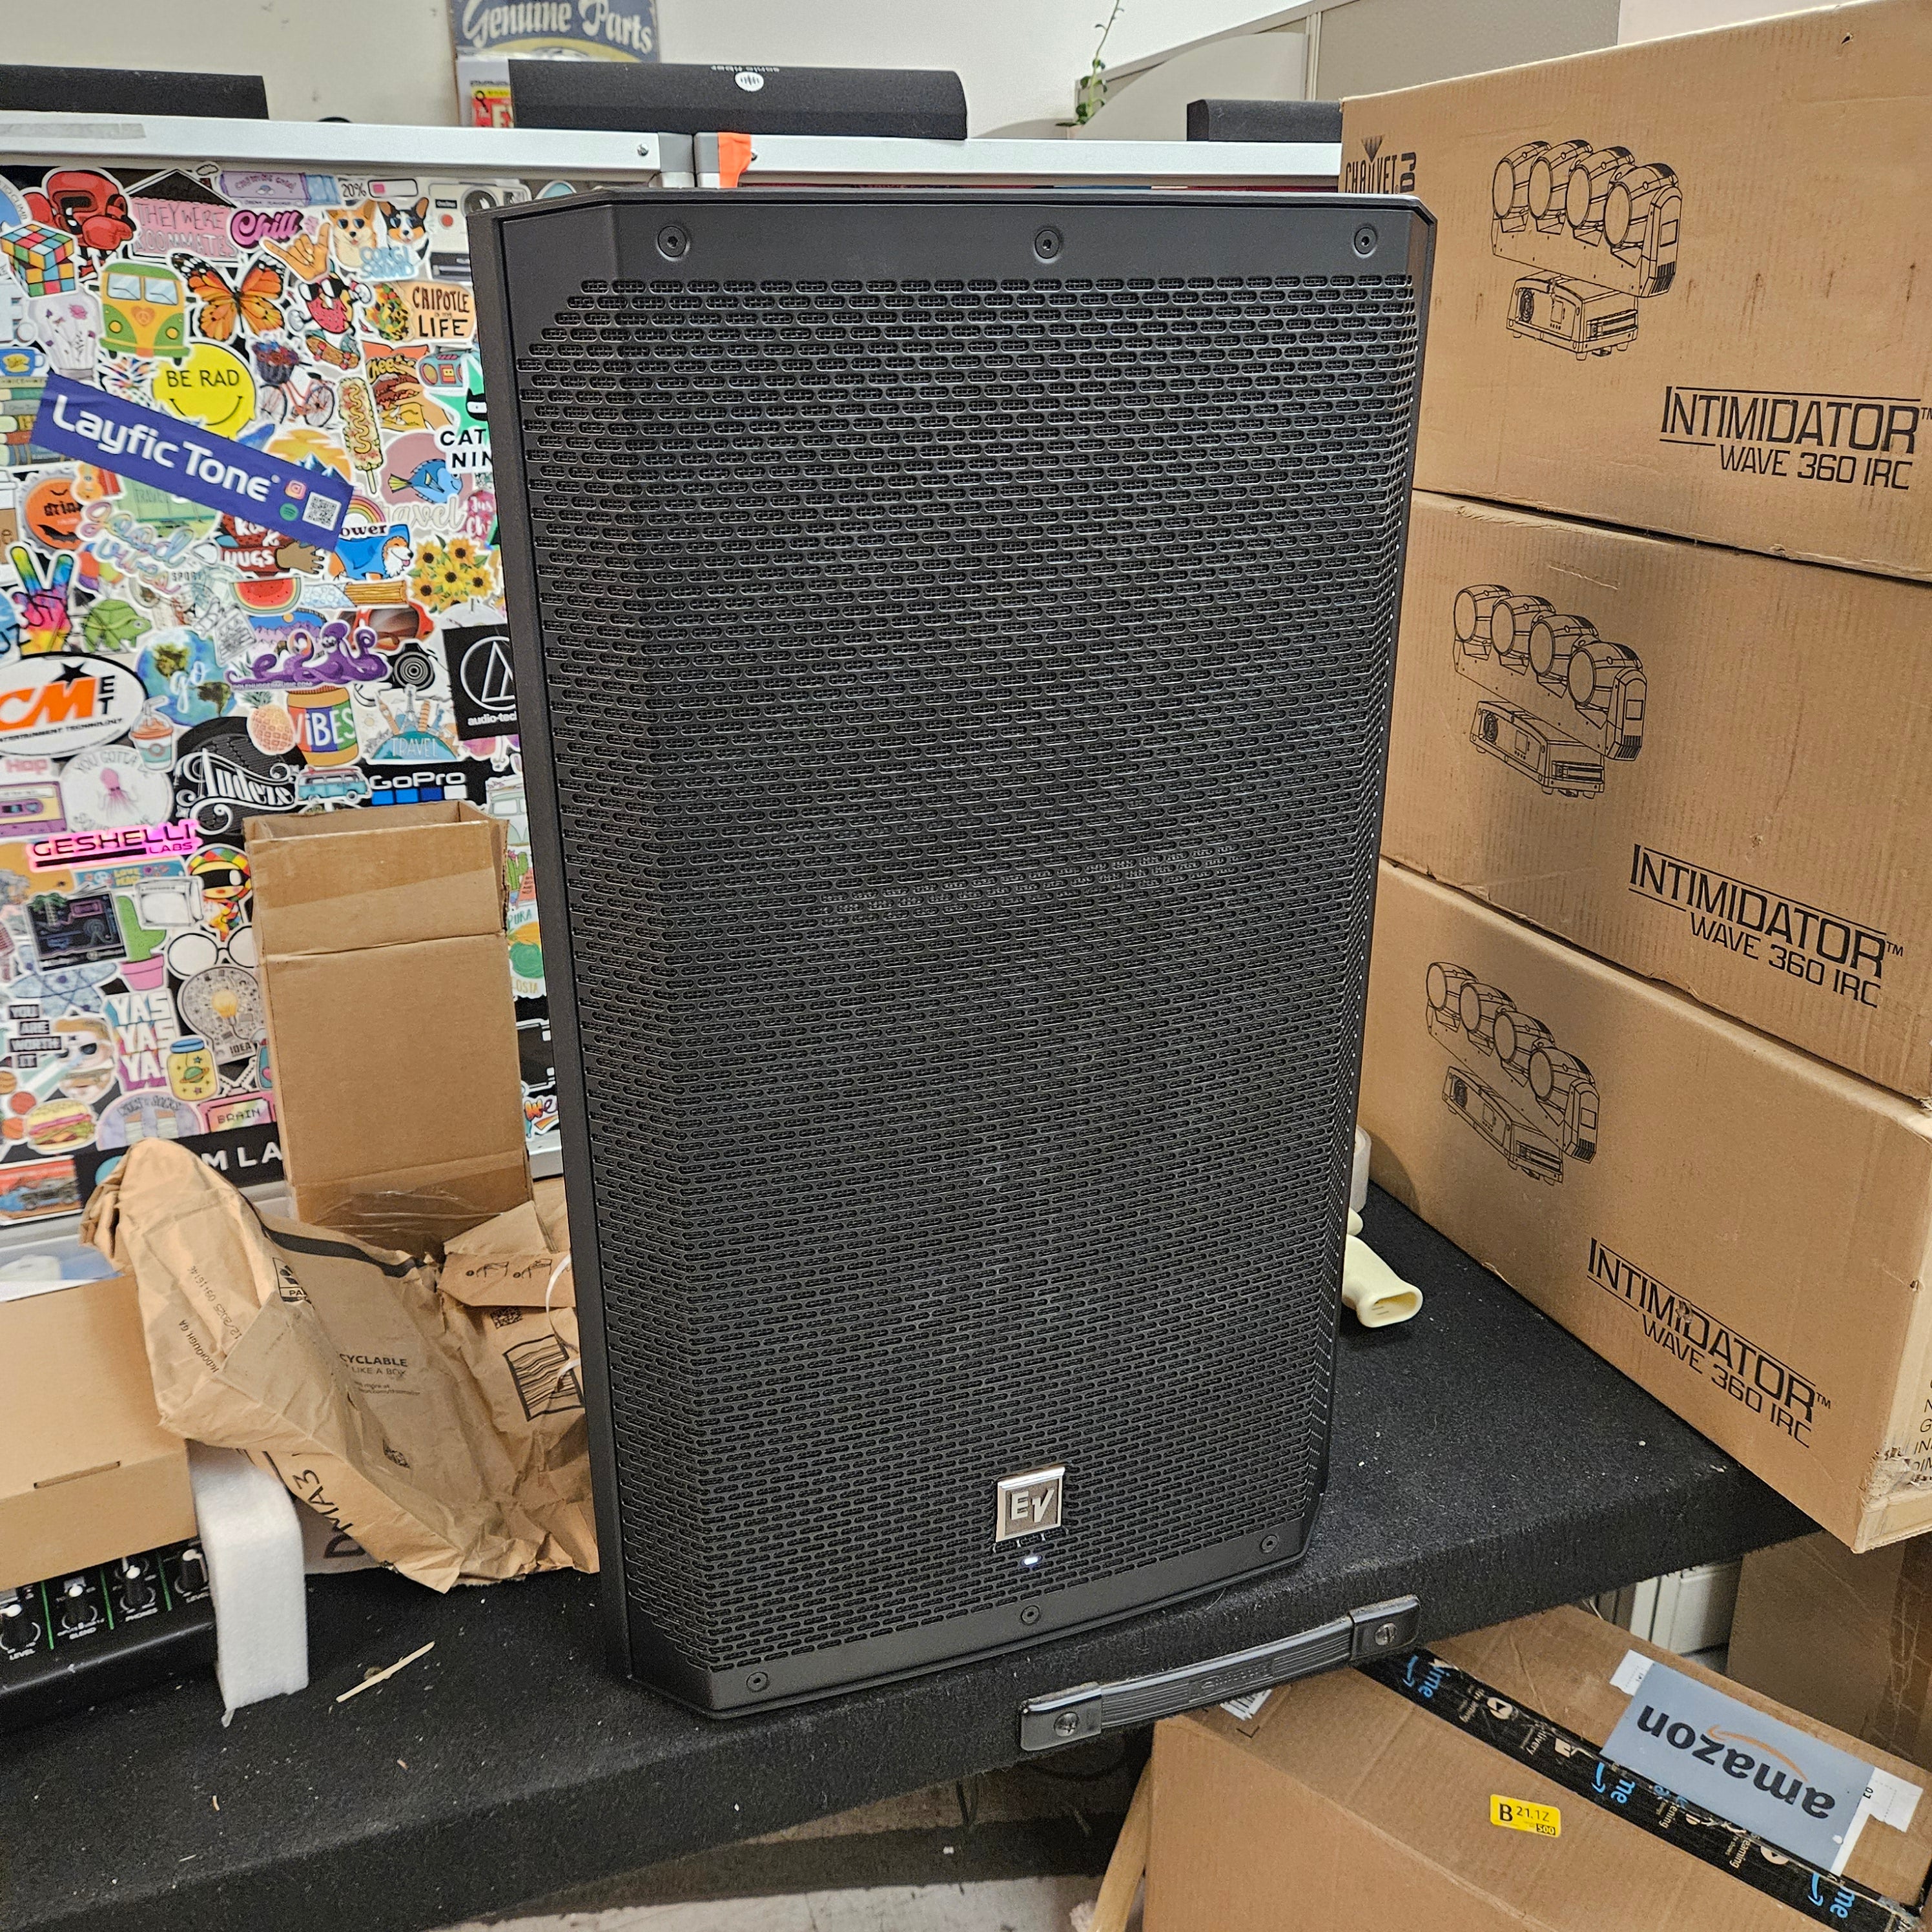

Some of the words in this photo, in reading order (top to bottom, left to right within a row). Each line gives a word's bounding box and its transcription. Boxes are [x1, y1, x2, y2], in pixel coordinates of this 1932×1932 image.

[341, 180, 367, 198] 20%
[134, 202, 176, 228] THEY
[183, 206, 225, 229] WERE
[231, 209, 304, 249] Chill
[136, 229, 238, 258] ROOMMATES
[413, 285, 470, 313] CHIPOTLE
[418, 314, 468, 337] LIFE
[167, 371, 191, 387] BE
[201, 369, 240, 387] RAD
[1661, 386, 1920, 455] INTIMIDATOR
[52, 395, 180, 468] Layfic
[181, 440, 273, 503] Tone
[440, 429, 486, 447] CAT
[1720, 444, 1790, 477] WAVE
[1797, 452, 1856, 483] 360
[1863, 458, 1913, 490] IRC
[224, 549, 275, 569] HUGS
[169, 661, 206, 714] go
[65, 718, 123, 732] TECHNOLOGY
[391, 737, 438, 757] TRAVEL
[370, 772, 466, 790] GoPro
[33, 823, 191, 858] GESHELLI
[149, 841, 194, 854] LABS
[1630, 843, 1886, 979] INTIMIDATOR
[1690, 912, 1761, 960] WAVE
[1768, 943, 1825, 987] 360
[1833, 969, 1881, 1009] IRC
[110, 991, 170, 1025] YAS
[229, 1042, 252, 1054] IDEA
[217, 1107, 262, 1124] BRAIN
[1641, 1313, 1704, 1375] WAVE
[1711, 1363, 1763, 1413] 360
[1770, 1403, 1812, 1448] IRC
[1011, 1488, 1054, 1523] EV
[1637, 1705, 1836, 1819] amazon
[1499, 1802, 1513, 1822] B
[1537, 1824, 1555, 1835] 500
